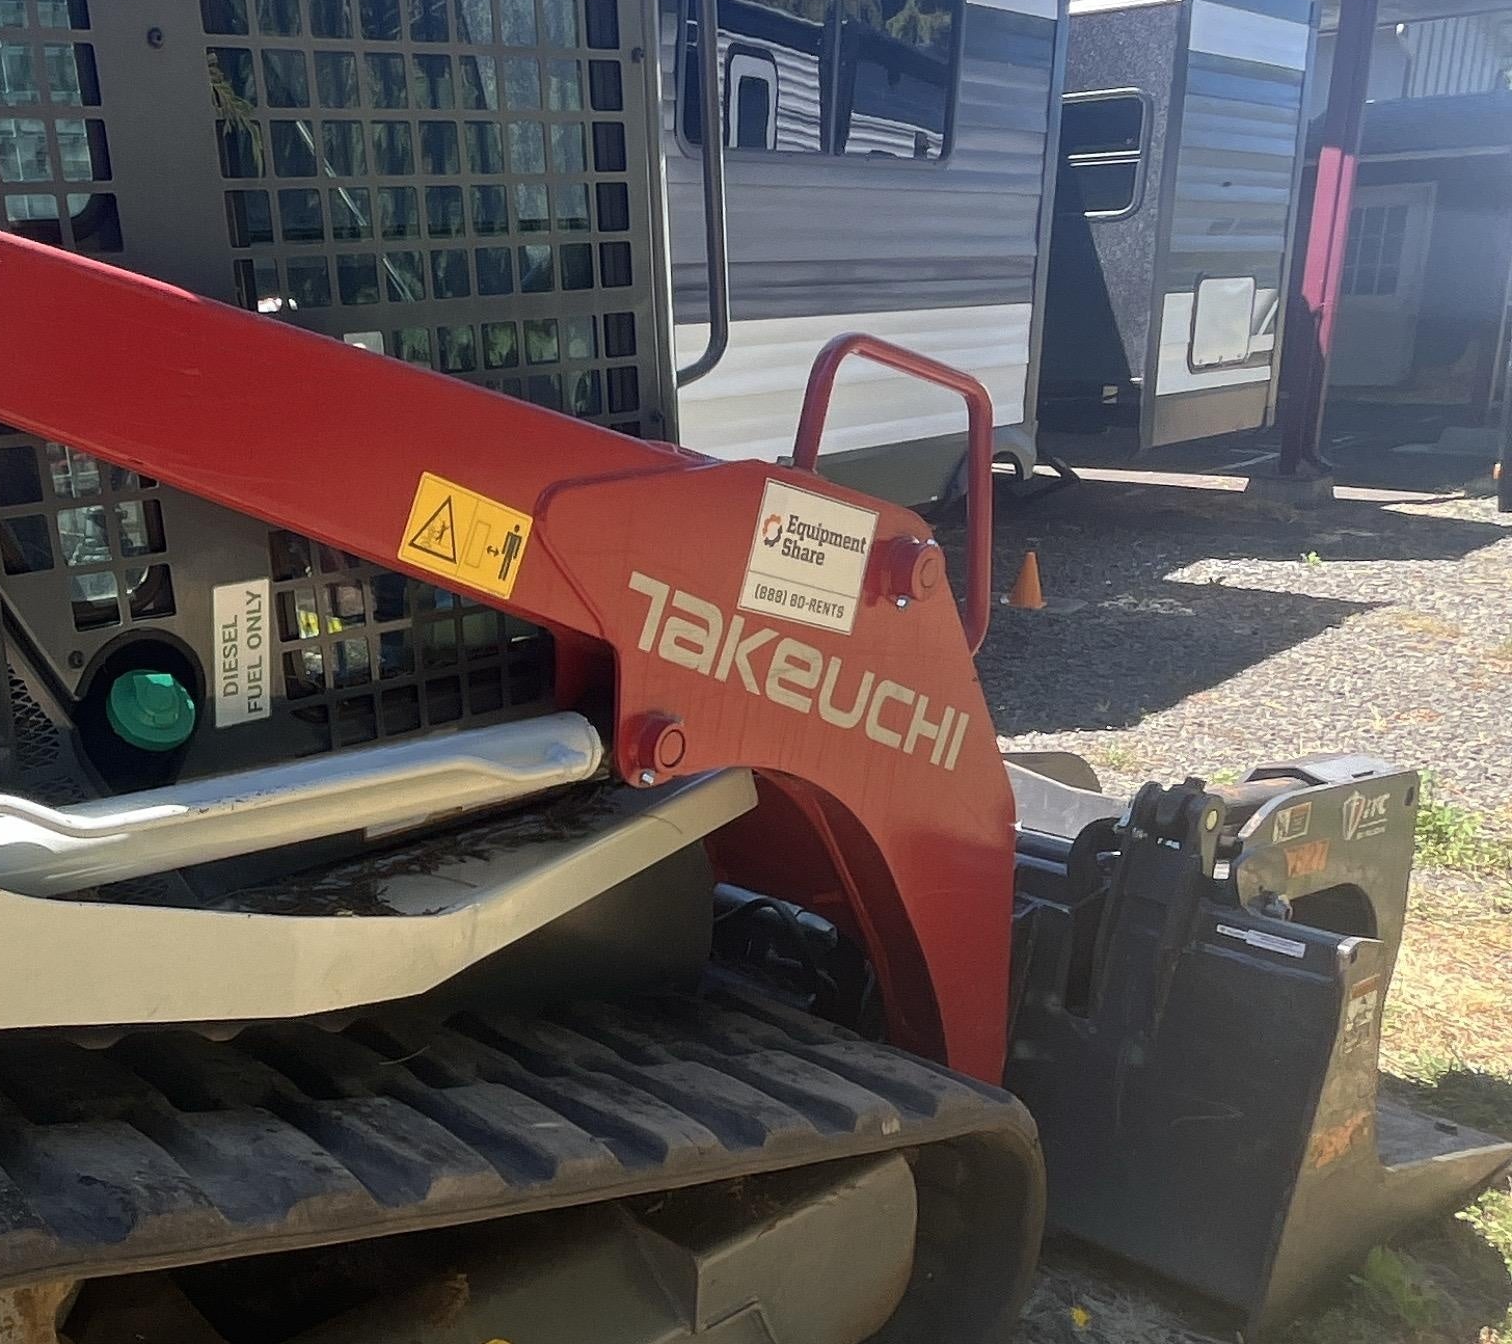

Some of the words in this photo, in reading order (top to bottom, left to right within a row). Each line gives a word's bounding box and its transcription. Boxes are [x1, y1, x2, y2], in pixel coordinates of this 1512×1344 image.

[781, 537, 825, 566] Share
[786, 514, 867, 554] Equipment
[246, 590, 263, 650] ONLY
[754, 583, 787, 606] (888)
[789, 593, 845, 619] 80-RENTS
[222, 614, 239, 698] DIESEL
[248, 655, 263, 714] FUEL
